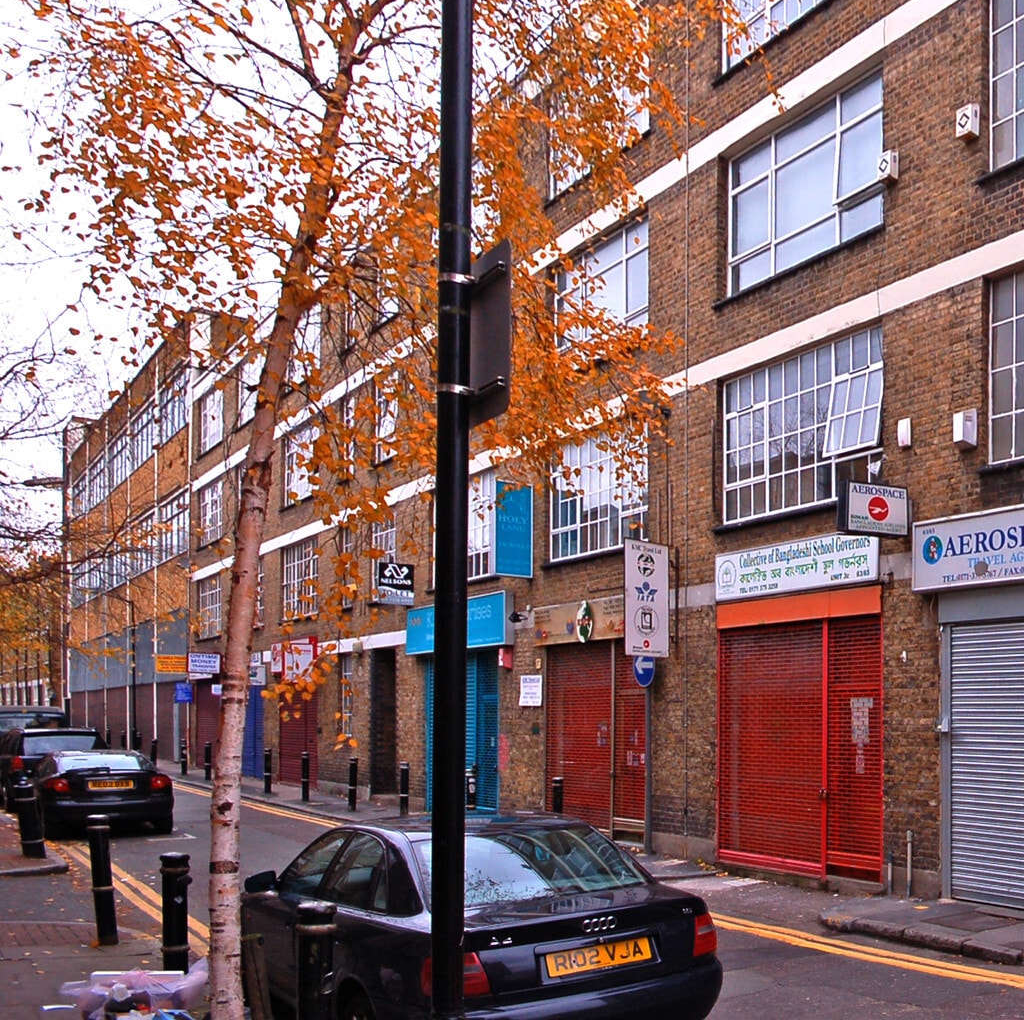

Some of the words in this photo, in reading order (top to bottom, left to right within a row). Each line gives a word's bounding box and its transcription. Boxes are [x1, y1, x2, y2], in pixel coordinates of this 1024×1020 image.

[852, 484, 905, 500] AEROSPACE
[498, 513, 529, 525] HOLY
[739, 551, 767, 569] Collective
[767, 549, 775, 564] of
[775, 542, 812, 564] Bangladeshi
[812, 538, 834, 557] School
[835, 536, 871, 553] Governors
[380, 577, 412, 586] NELSONS
[637, 594, 655, 602] IATA
[605, 940, 644, 961] VJA
